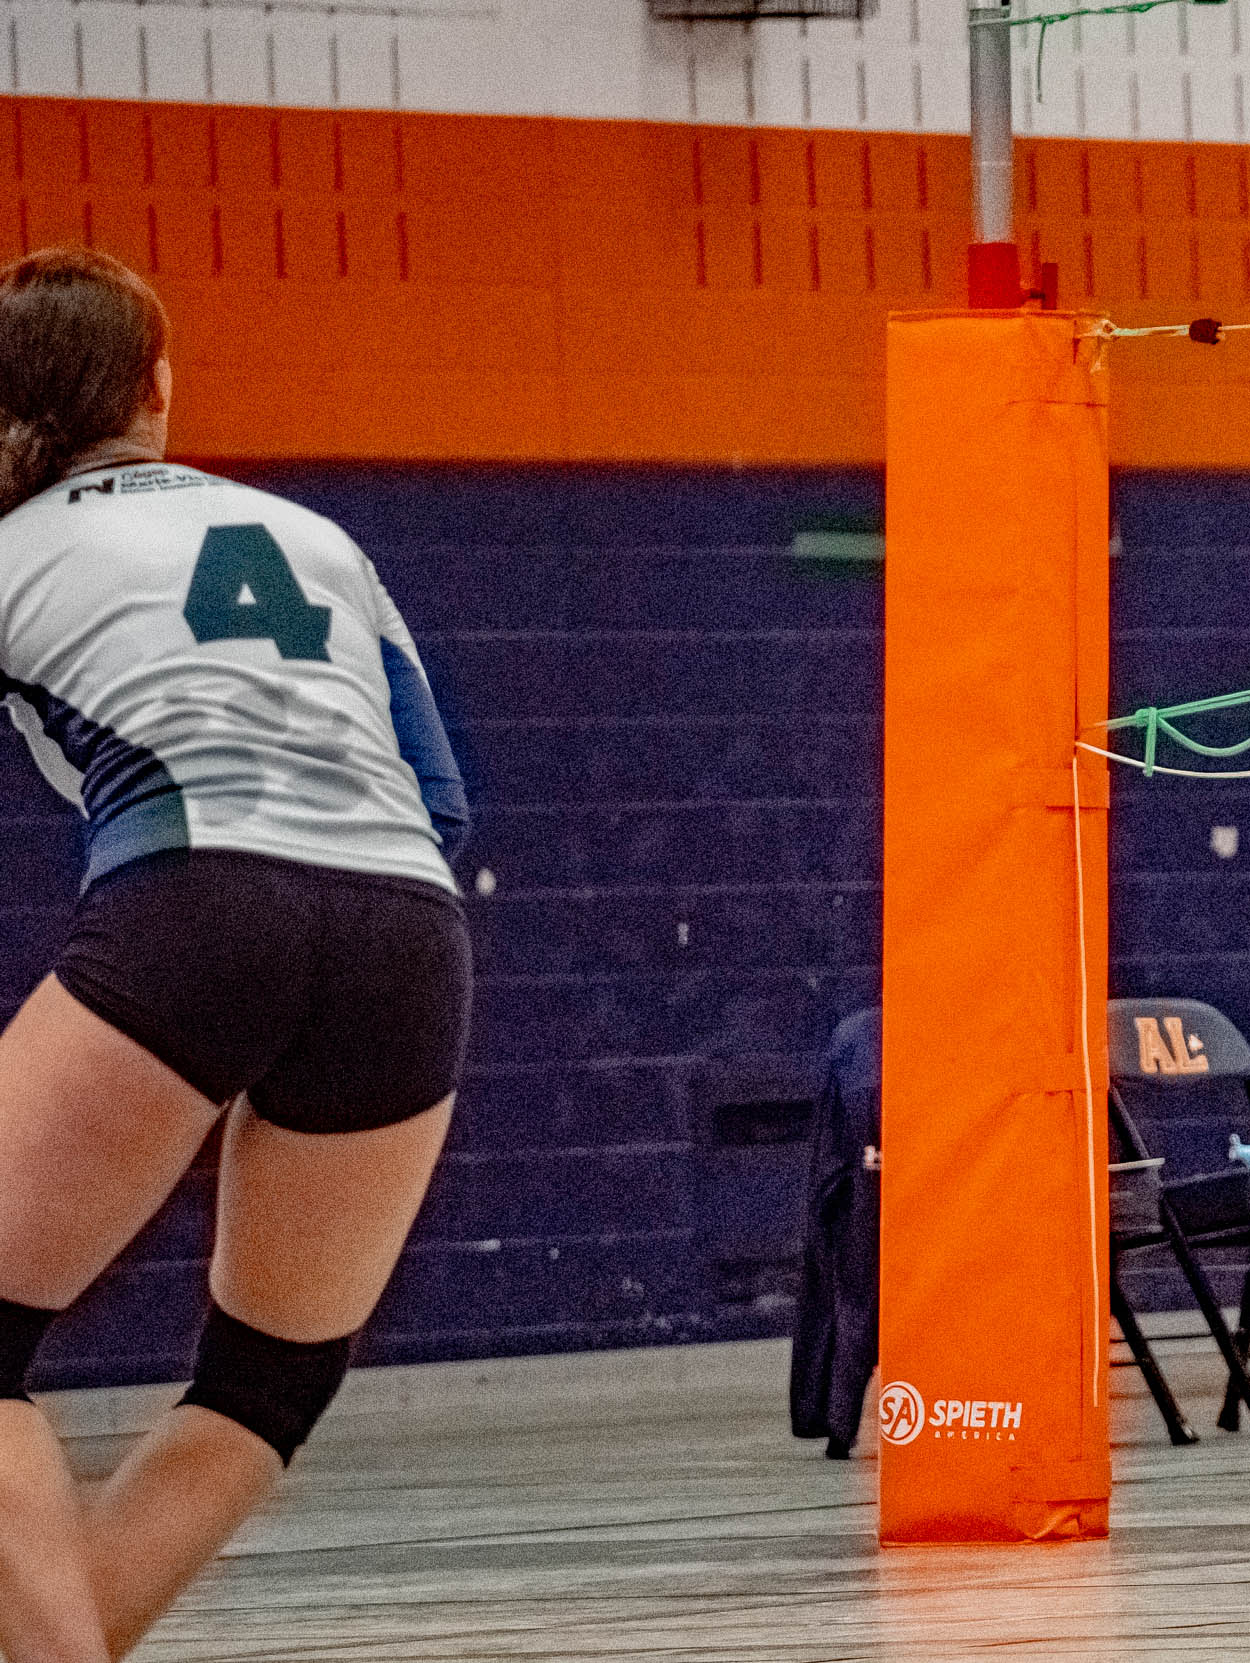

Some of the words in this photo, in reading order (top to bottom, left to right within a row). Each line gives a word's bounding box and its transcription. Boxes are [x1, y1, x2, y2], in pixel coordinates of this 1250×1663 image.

[184, 523, 333, 662] 4
[1135, 1016, 1209, 1075] AL
[928, 1399, 1023, 1429] SPIETH
[933, 1430, 1017, 1441] AMERICA
